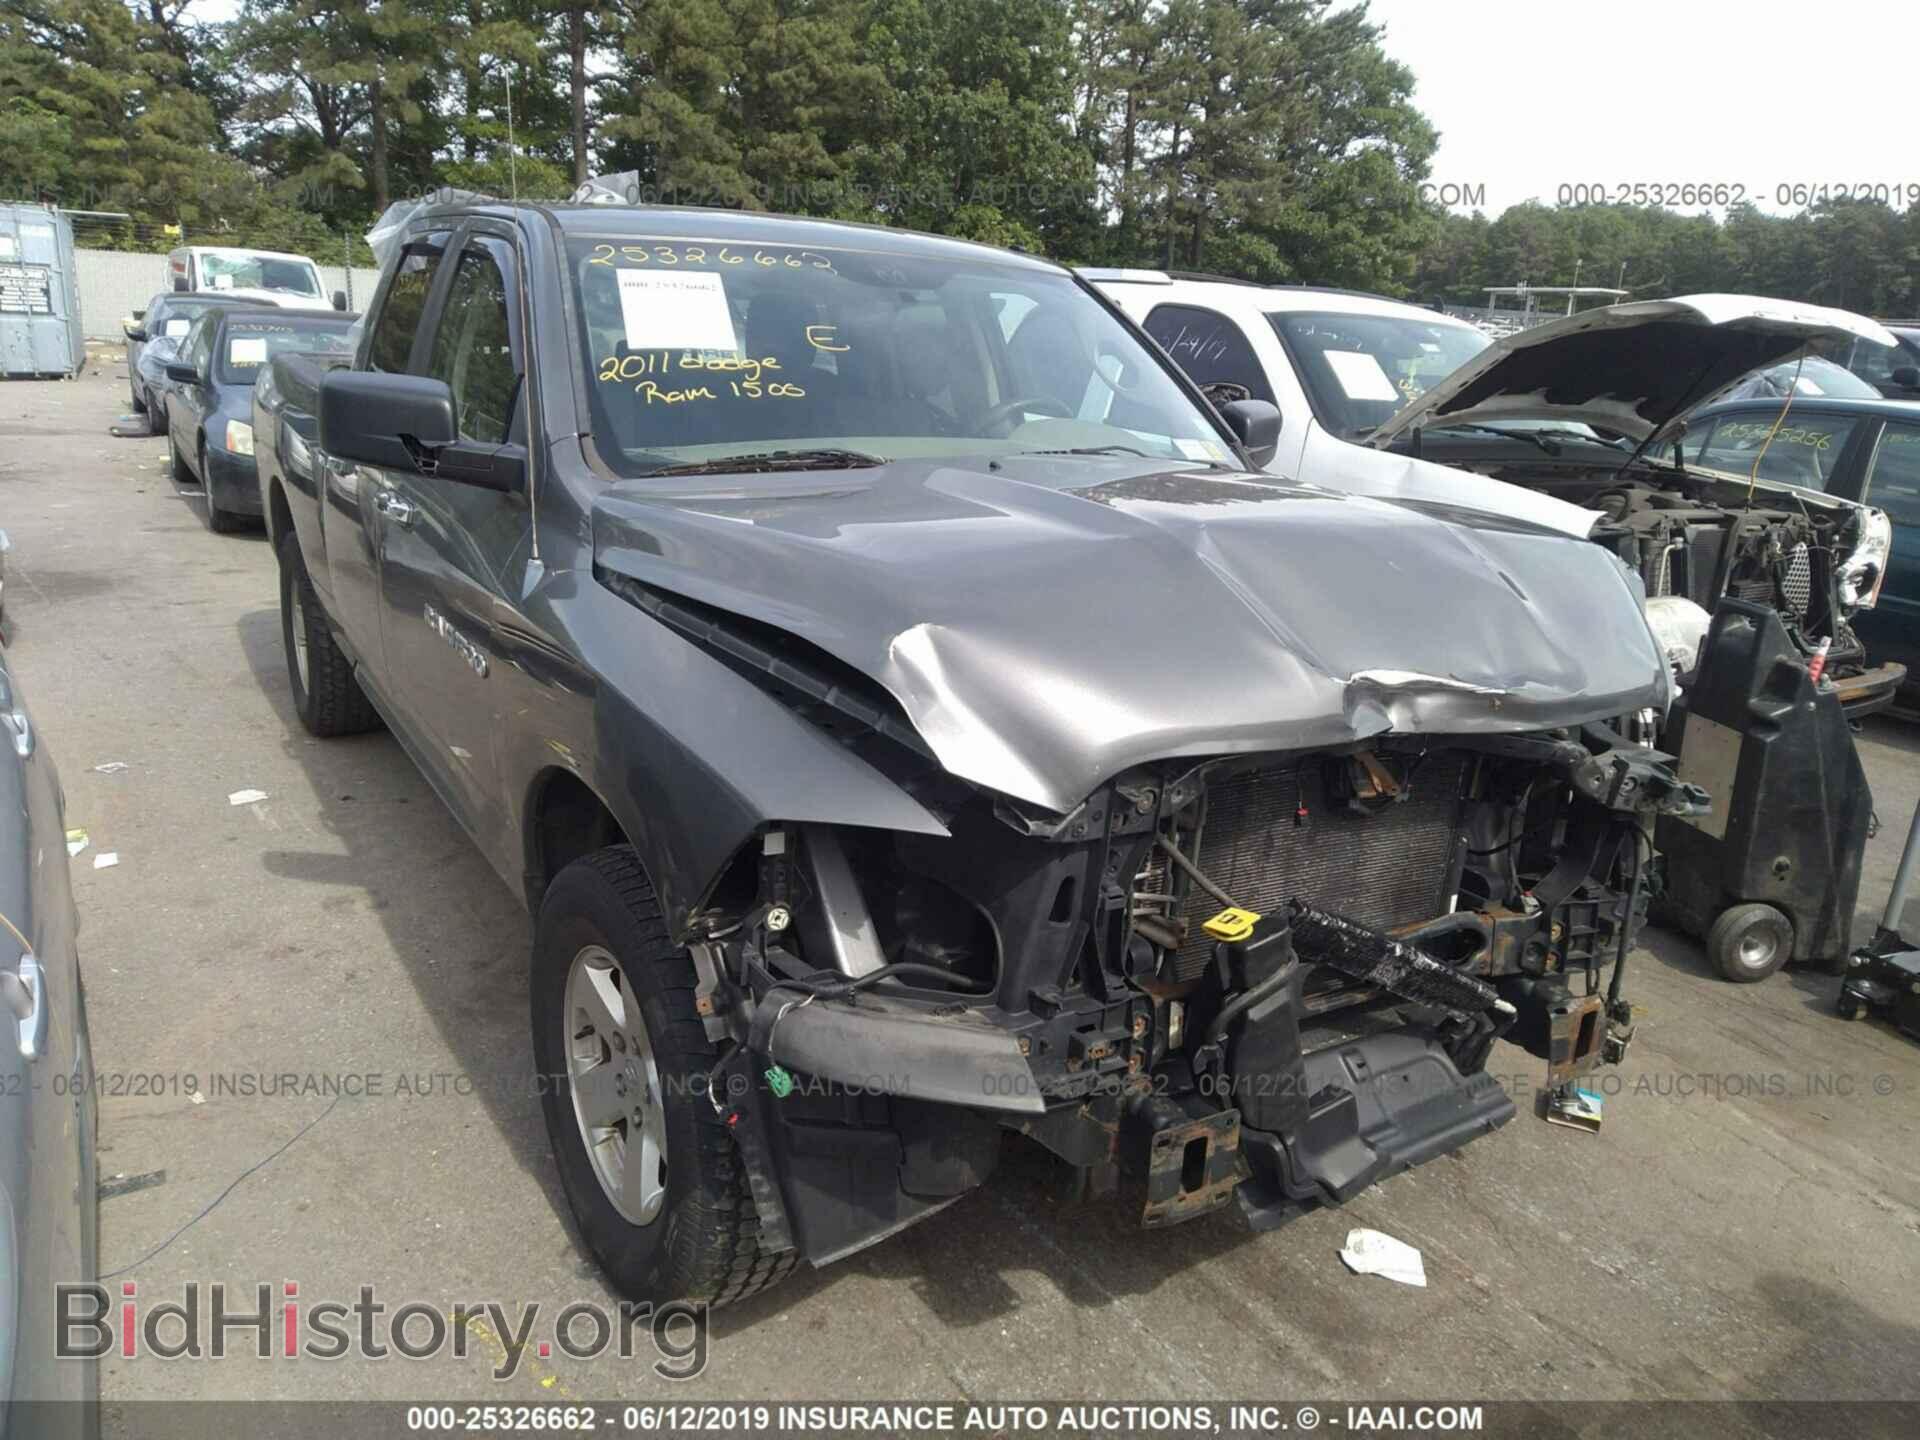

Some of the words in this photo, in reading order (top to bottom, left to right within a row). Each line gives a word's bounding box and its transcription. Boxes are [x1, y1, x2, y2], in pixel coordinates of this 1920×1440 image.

[590, 244, 838, 276] 25326662
[599, 353, 668, 382] 2011
[636, 381, 717, 404] Ram
[731, 382, 806, 398] 1500
